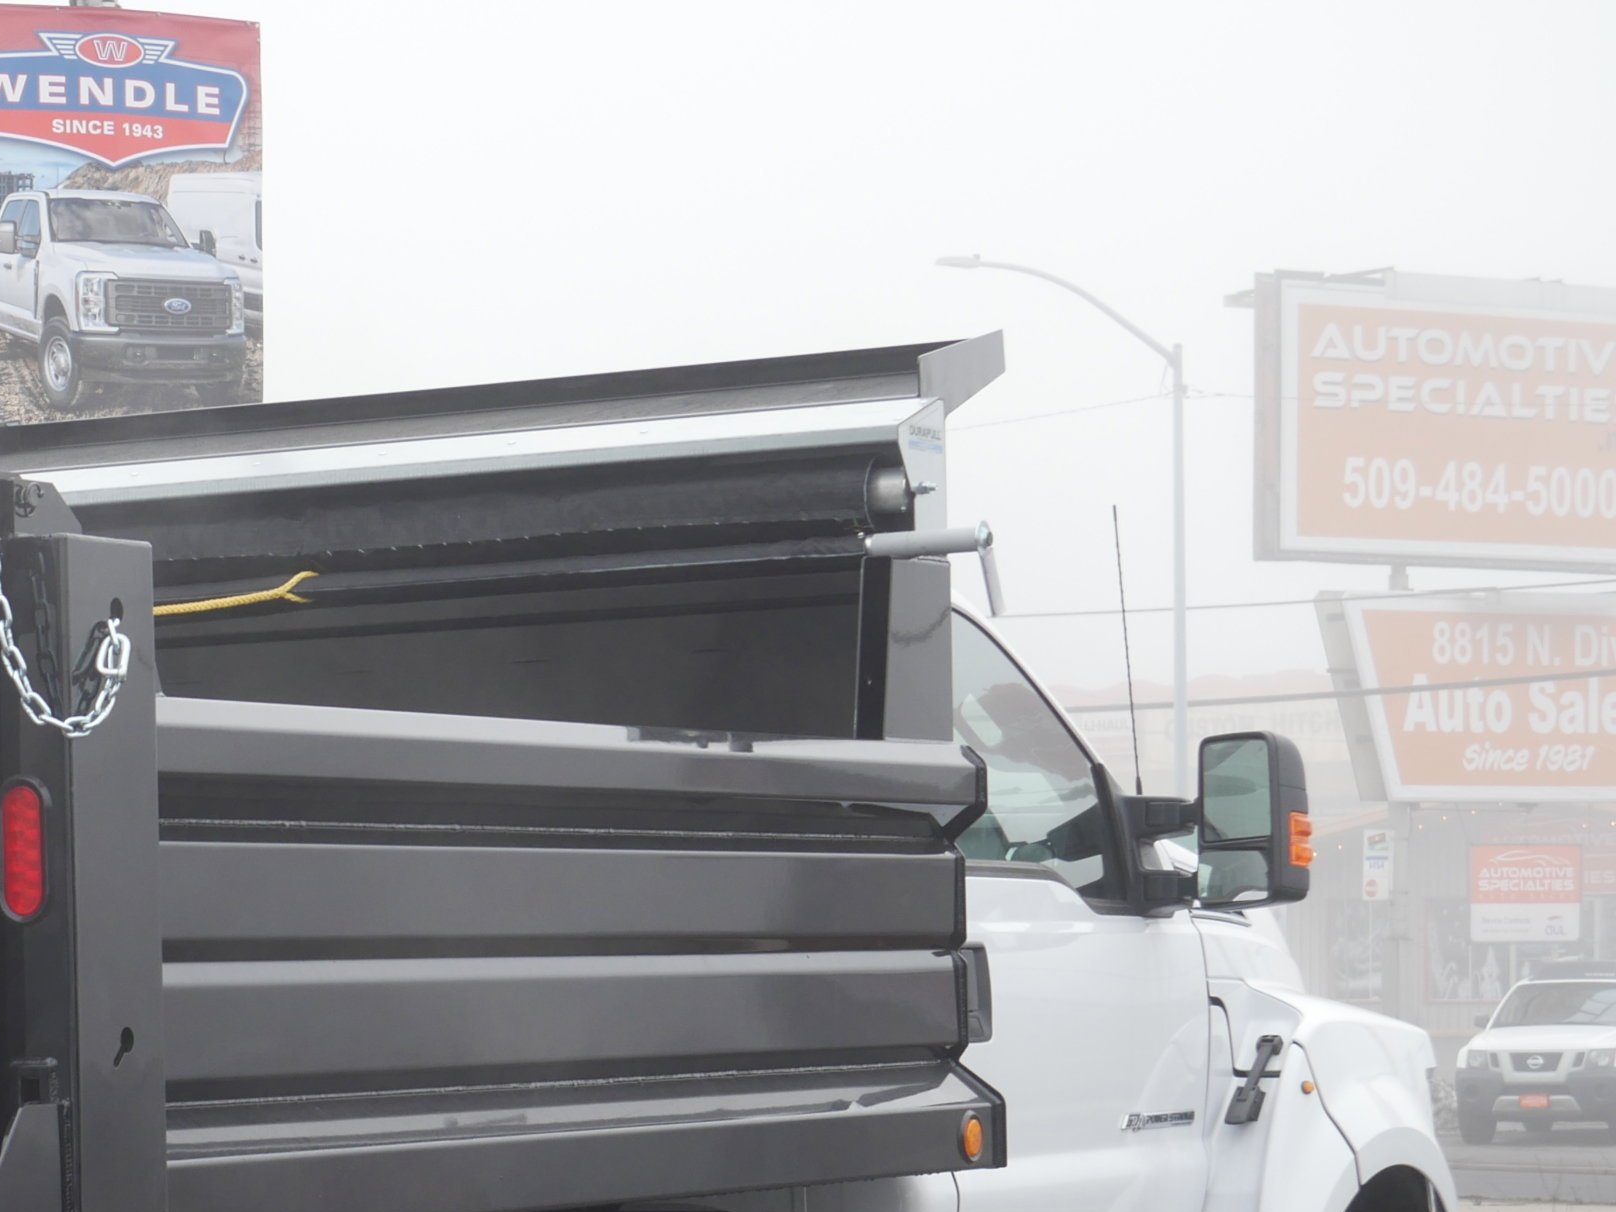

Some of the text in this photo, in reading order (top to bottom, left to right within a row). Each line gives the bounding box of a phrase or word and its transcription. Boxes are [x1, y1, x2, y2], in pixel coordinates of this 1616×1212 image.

[51, 119, 164, 139] SINCE 1943
[1312, 370, 1616, 425] SPECIALTIE
[1342, 457, 1616, 518] 509-484-5000
[1432, 620, 1515, 666] 8815
[1526, 624, 1561, 666] N.
[1403, 673, 1513, 733] Auto
[1463, 744, 1595, 772] Since 1981
[1477, 879, 1575, 891] SPECIALTIES
[1478, 867, 1575, 878] AUTOMOTIVE
